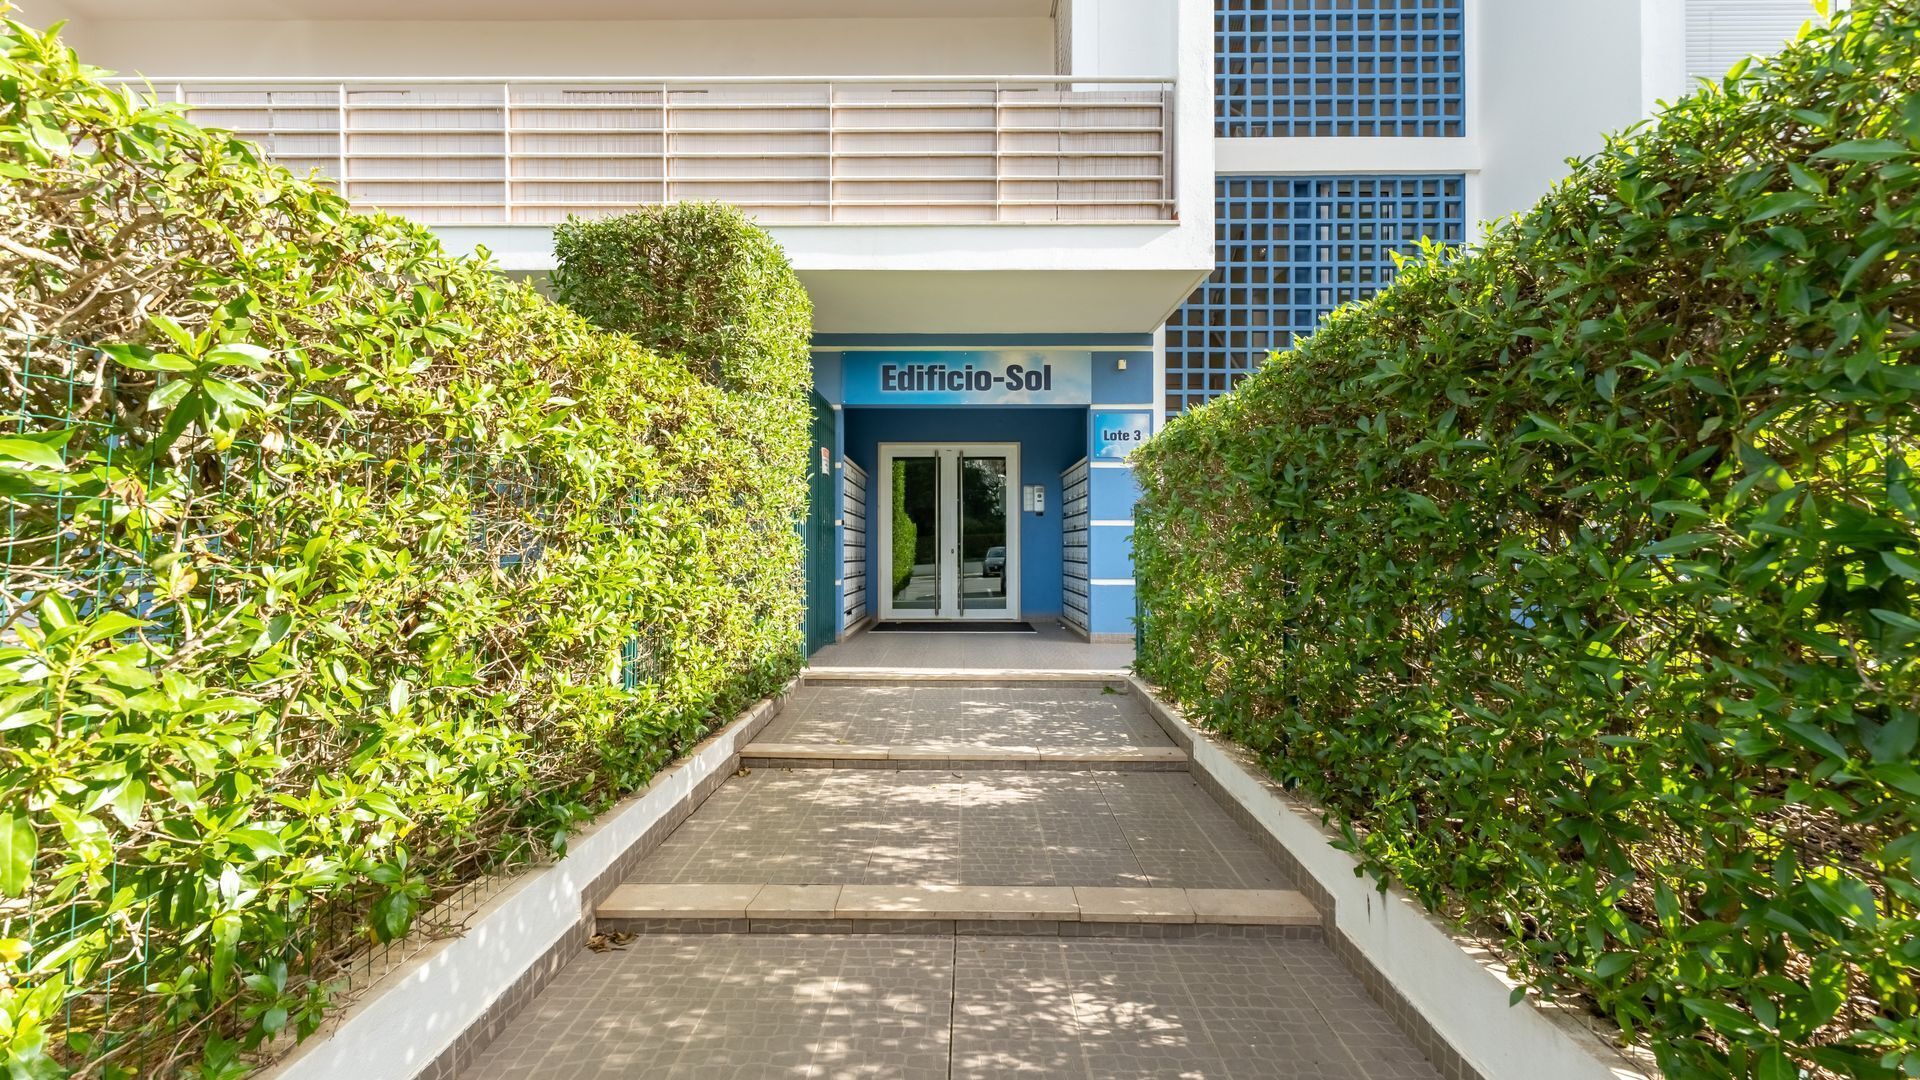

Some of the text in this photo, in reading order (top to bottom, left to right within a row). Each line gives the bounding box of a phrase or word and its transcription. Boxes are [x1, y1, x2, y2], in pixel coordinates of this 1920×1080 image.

[882, 364, 1052, 391] Edificio-Sol
[1103, 429, 1142, 441] Lote 3
